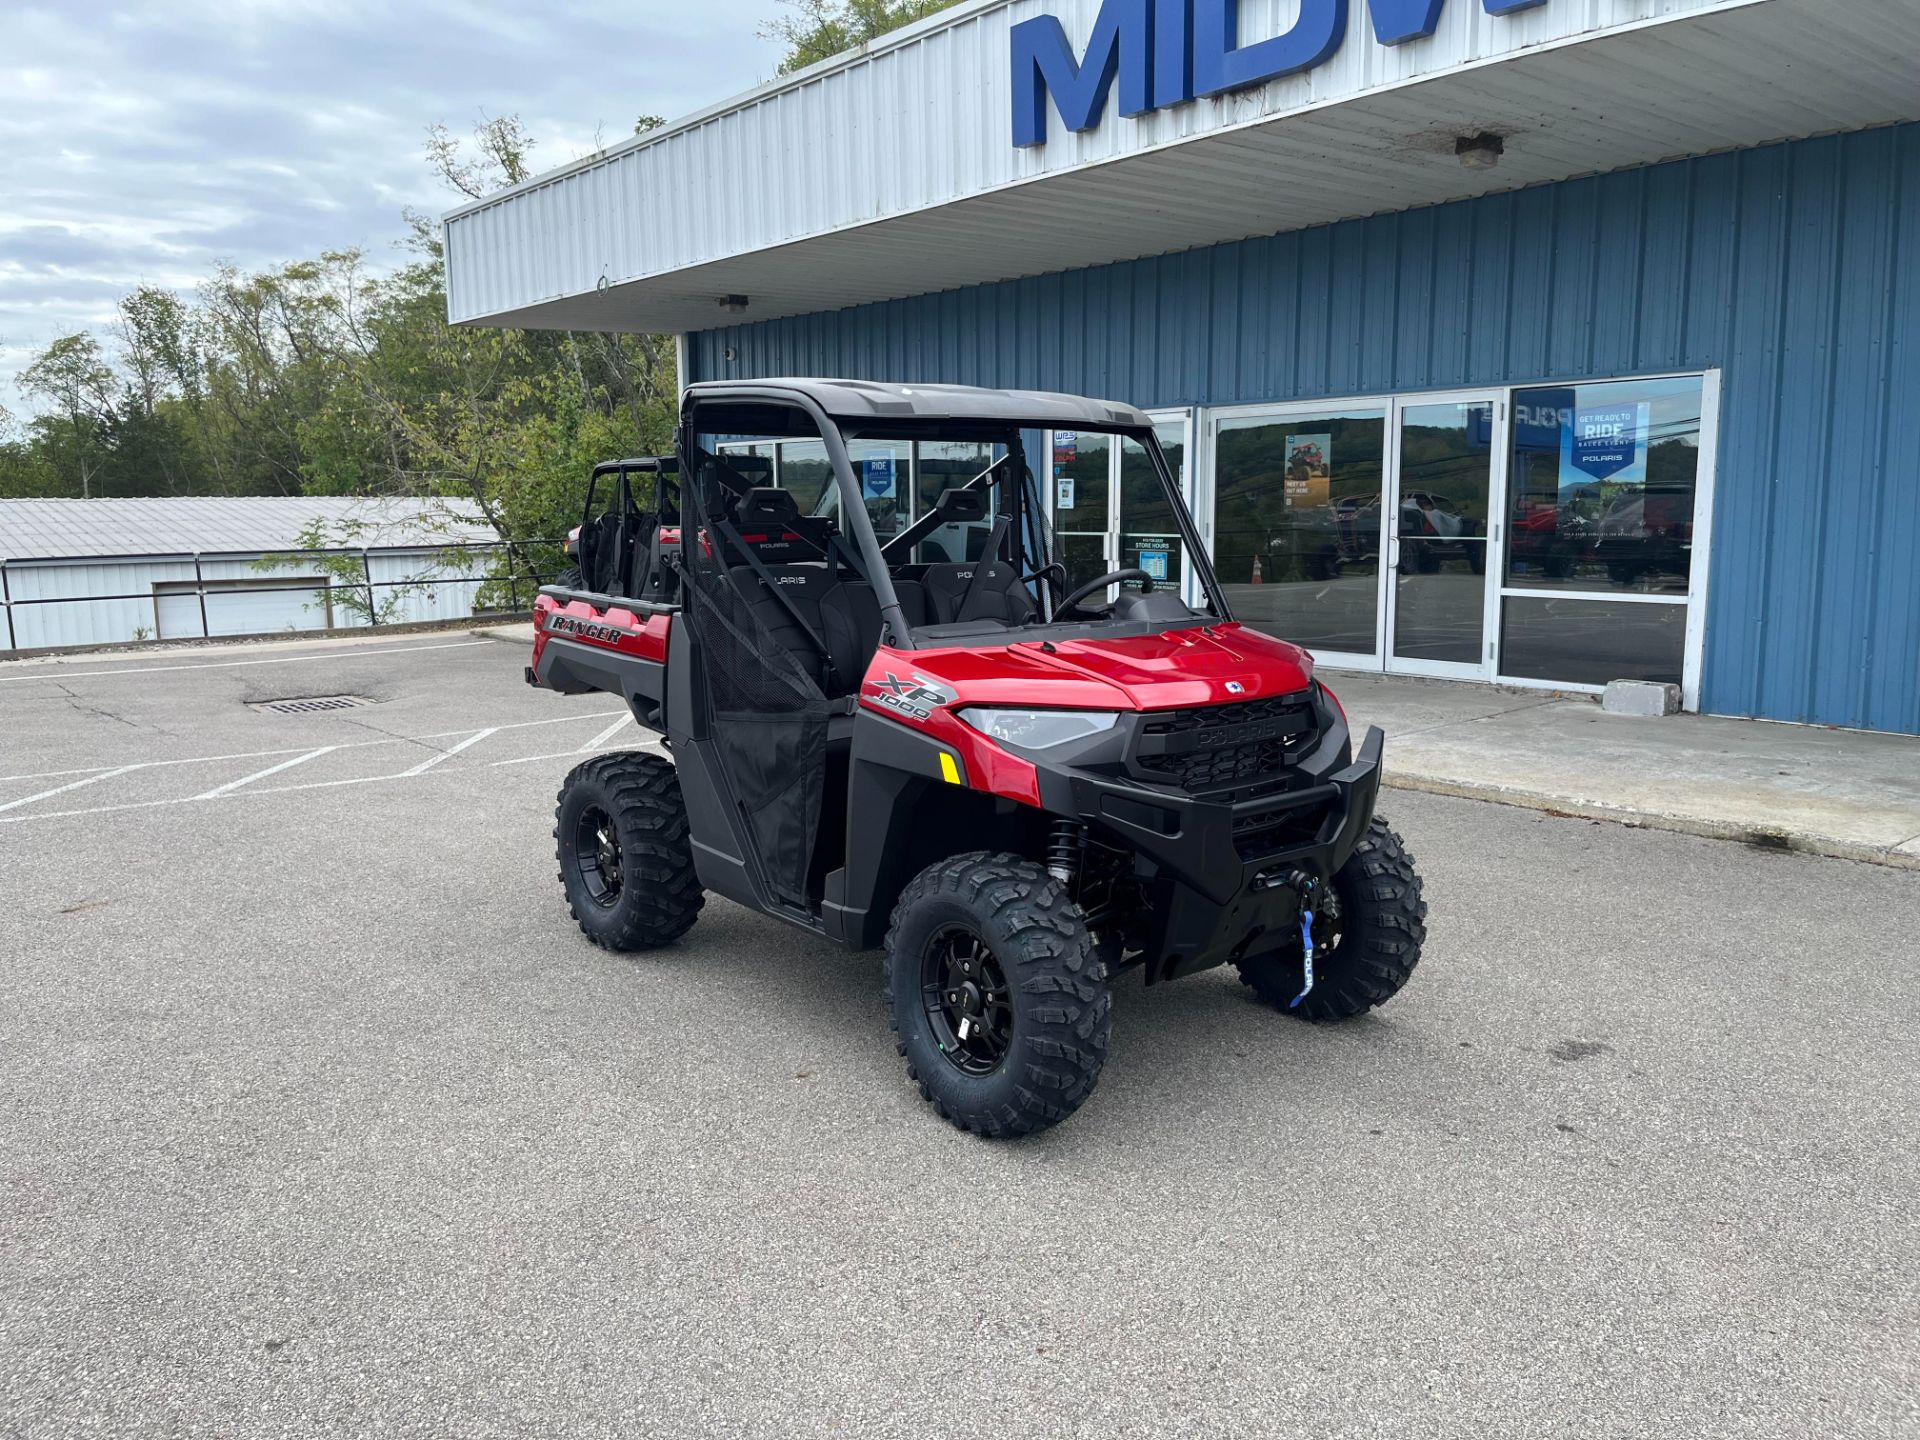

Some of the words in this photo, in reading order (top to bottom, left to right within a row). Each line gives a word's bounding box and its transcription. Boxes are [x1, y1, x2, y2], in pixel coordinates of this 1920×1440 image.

[1579, 415, 1594, 423] GET
[1595, 414, 1619, 422] READY
[1583, 423, 1625, 440] RIDE
[1582, 454, 1624, 463] POLARIS
[871, 461, 887, 471] RIDE
[760, 542, 790, 550] POLARIS
[553, 616, 622, 645] RANGER
[867, 671, 948, 706] XP
[874, 691, 932, 720] 1000
